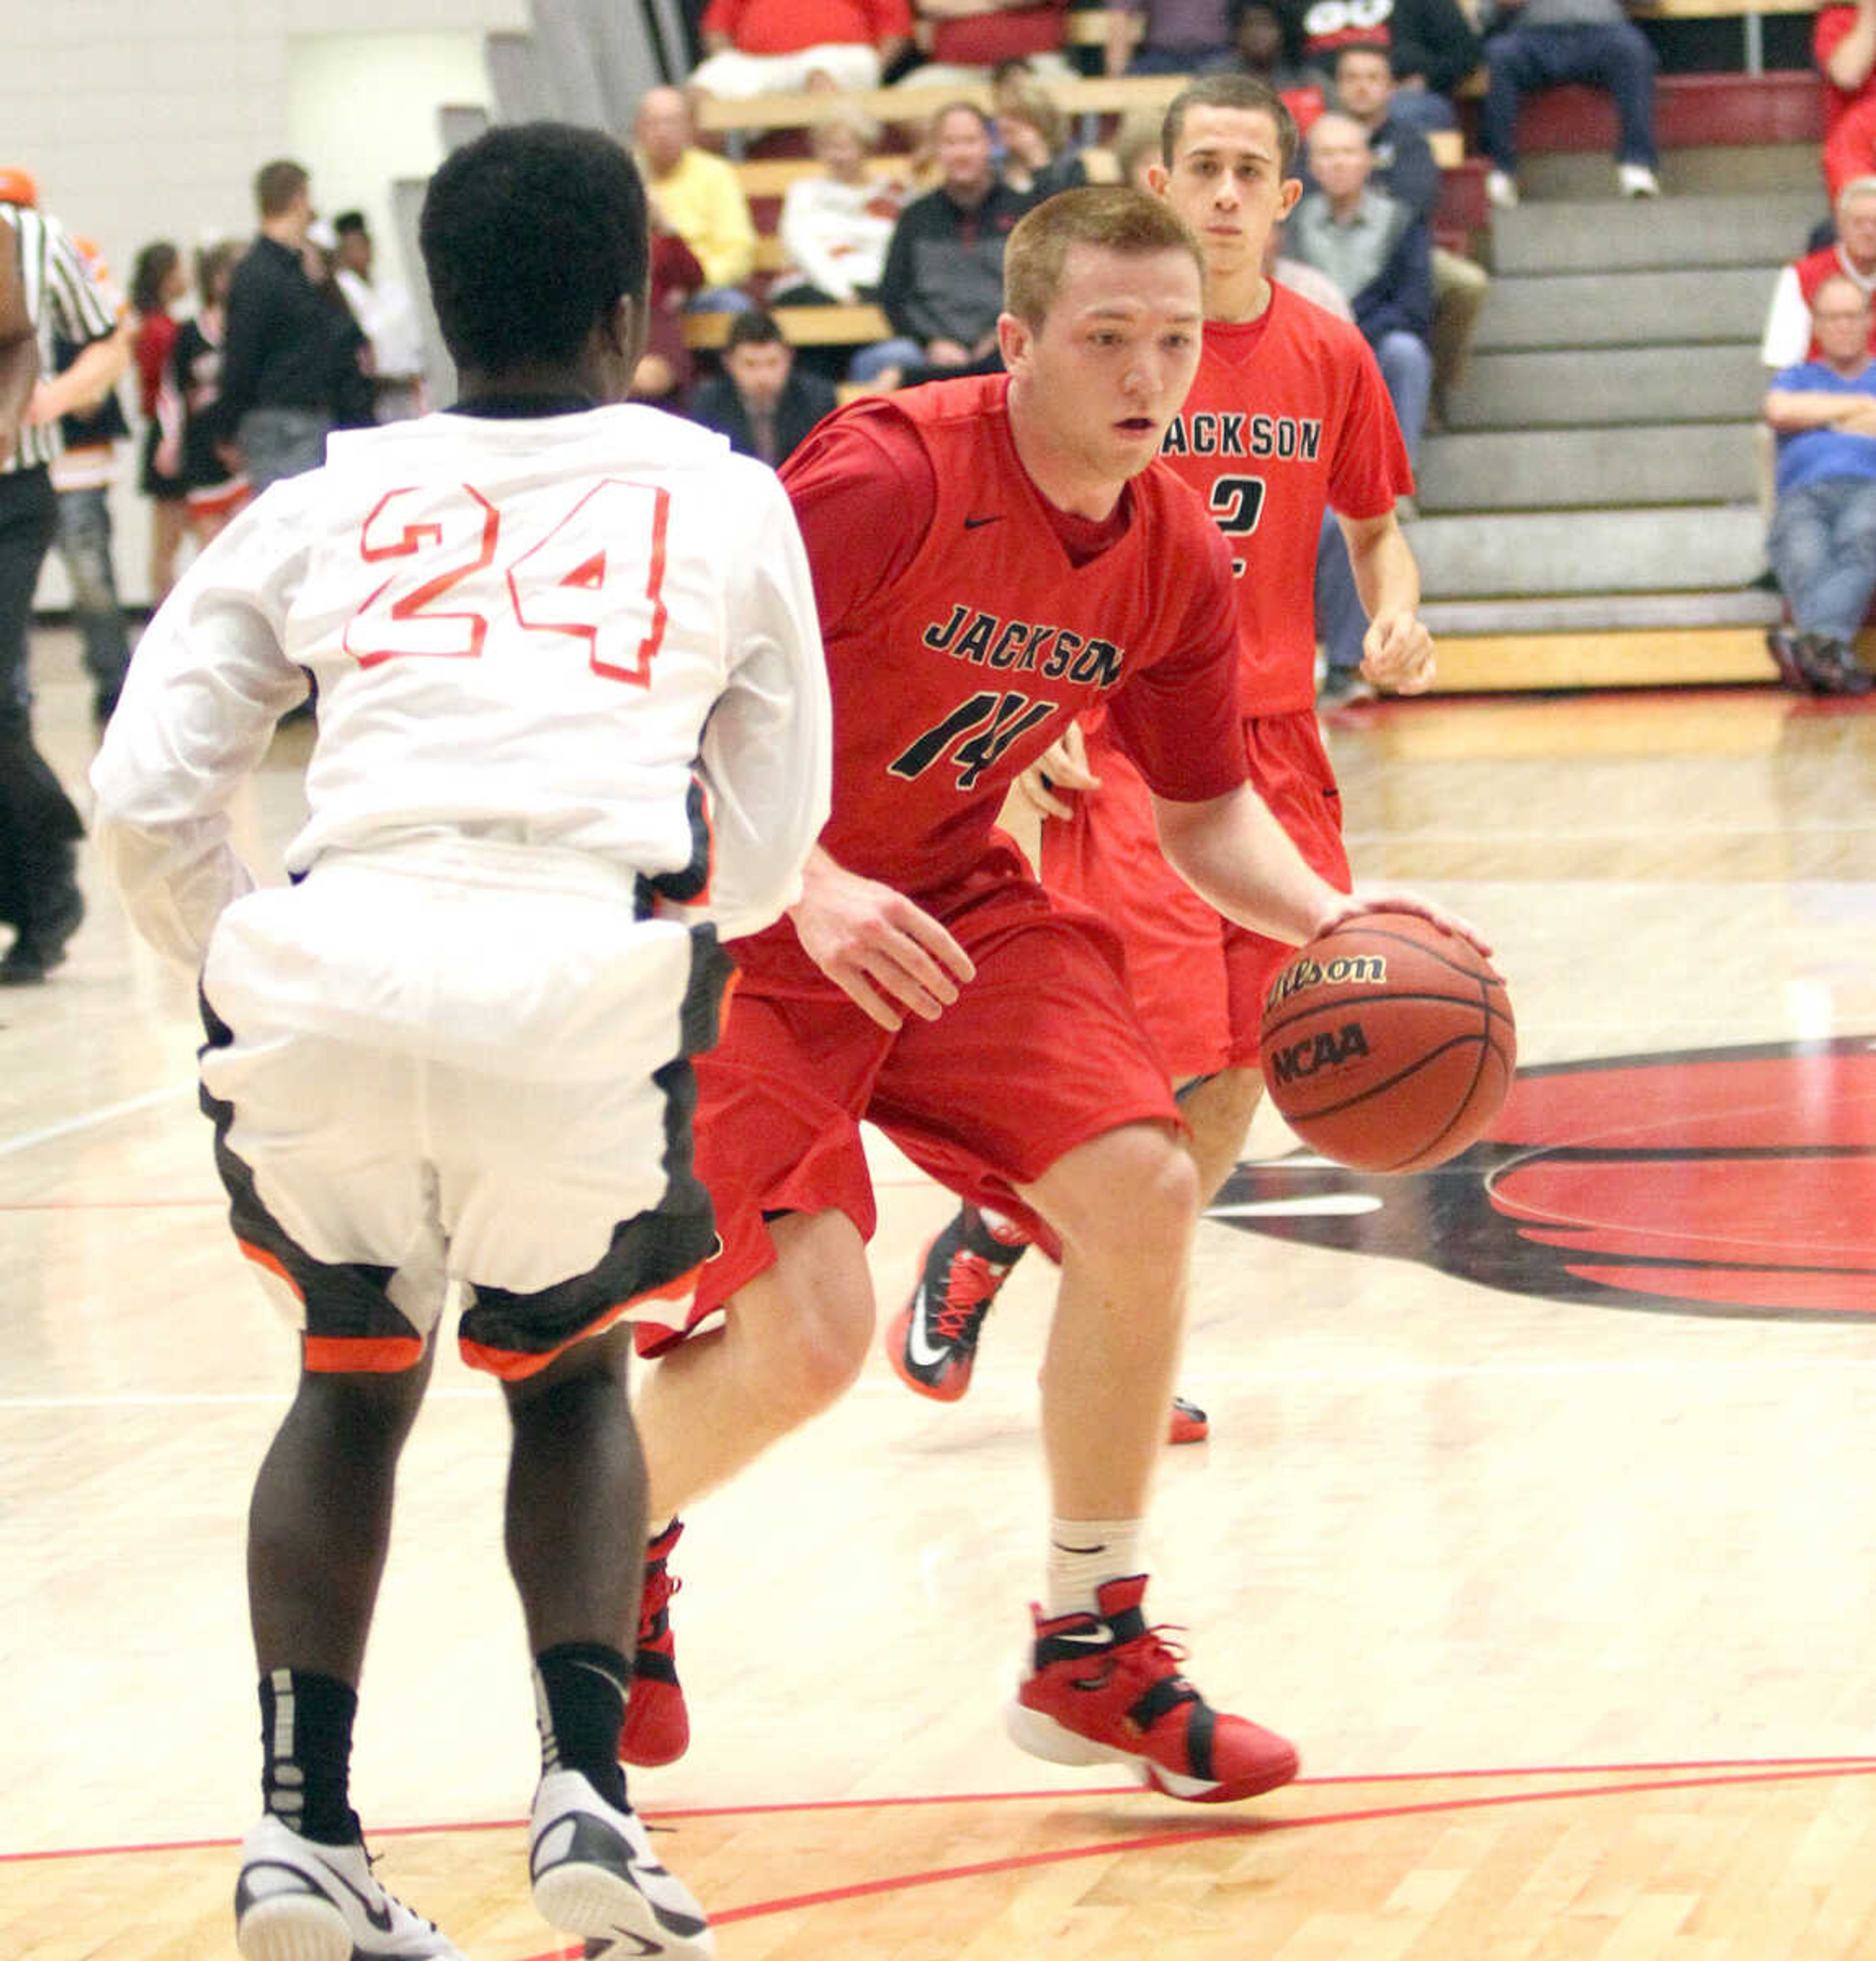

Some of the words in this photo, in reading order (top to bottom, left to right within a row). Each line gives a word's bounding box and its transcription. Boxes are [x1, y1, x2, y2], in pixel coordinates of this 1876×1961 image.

[1159, 411, 1322, 461] ACKSON
[342, 478, 671, 690] 24
[923, 603, 1125, 690] JACKSON
[887, 690, 1060, 791] 14
[1271, 1022, 1369, 1087] NCAA
